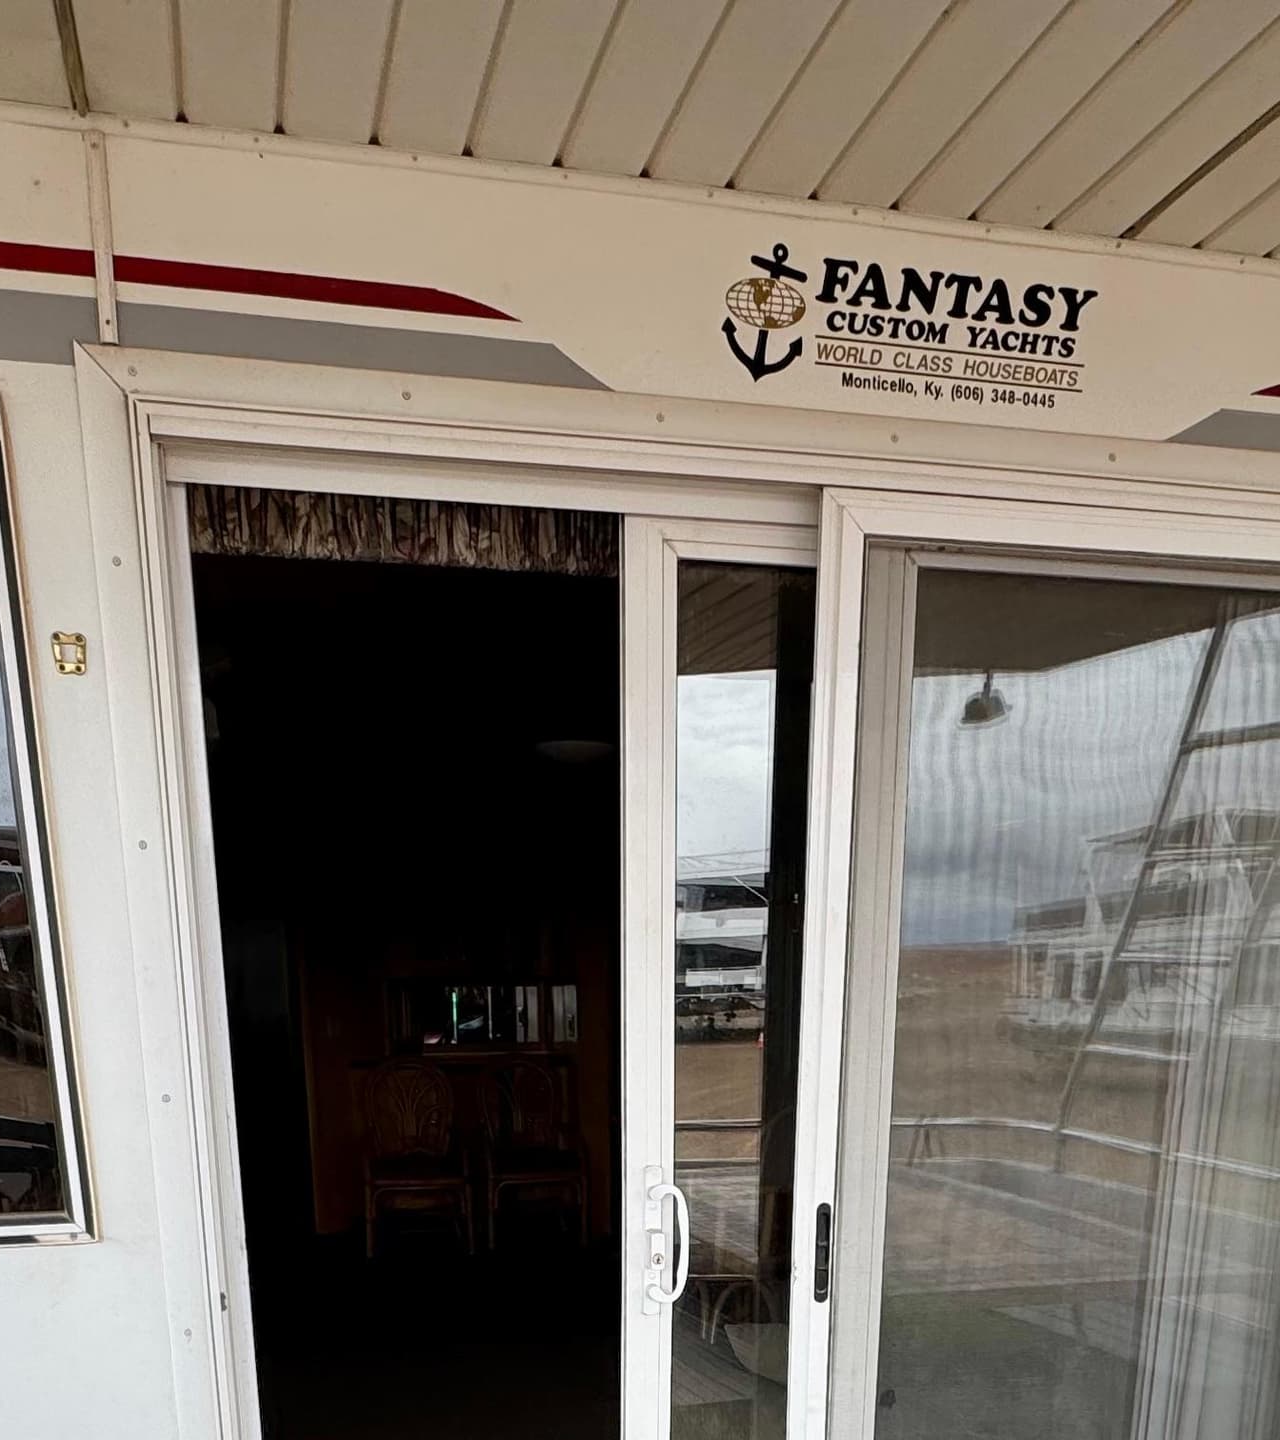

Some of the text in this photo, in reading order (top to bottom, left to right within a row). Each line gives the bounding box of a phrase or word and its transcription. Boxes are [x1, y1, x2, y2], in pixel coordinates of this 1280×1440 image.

[815, 257, 1098, 331] FANTASY
[826, 311, 1076, 358] CUSTOM YACHTS
[817, 342, 1079, 387] WORLD CLASS HOUSEBOATS
[841, 371, 1056, 409] Monticello, Ky. (606) 348-0445
